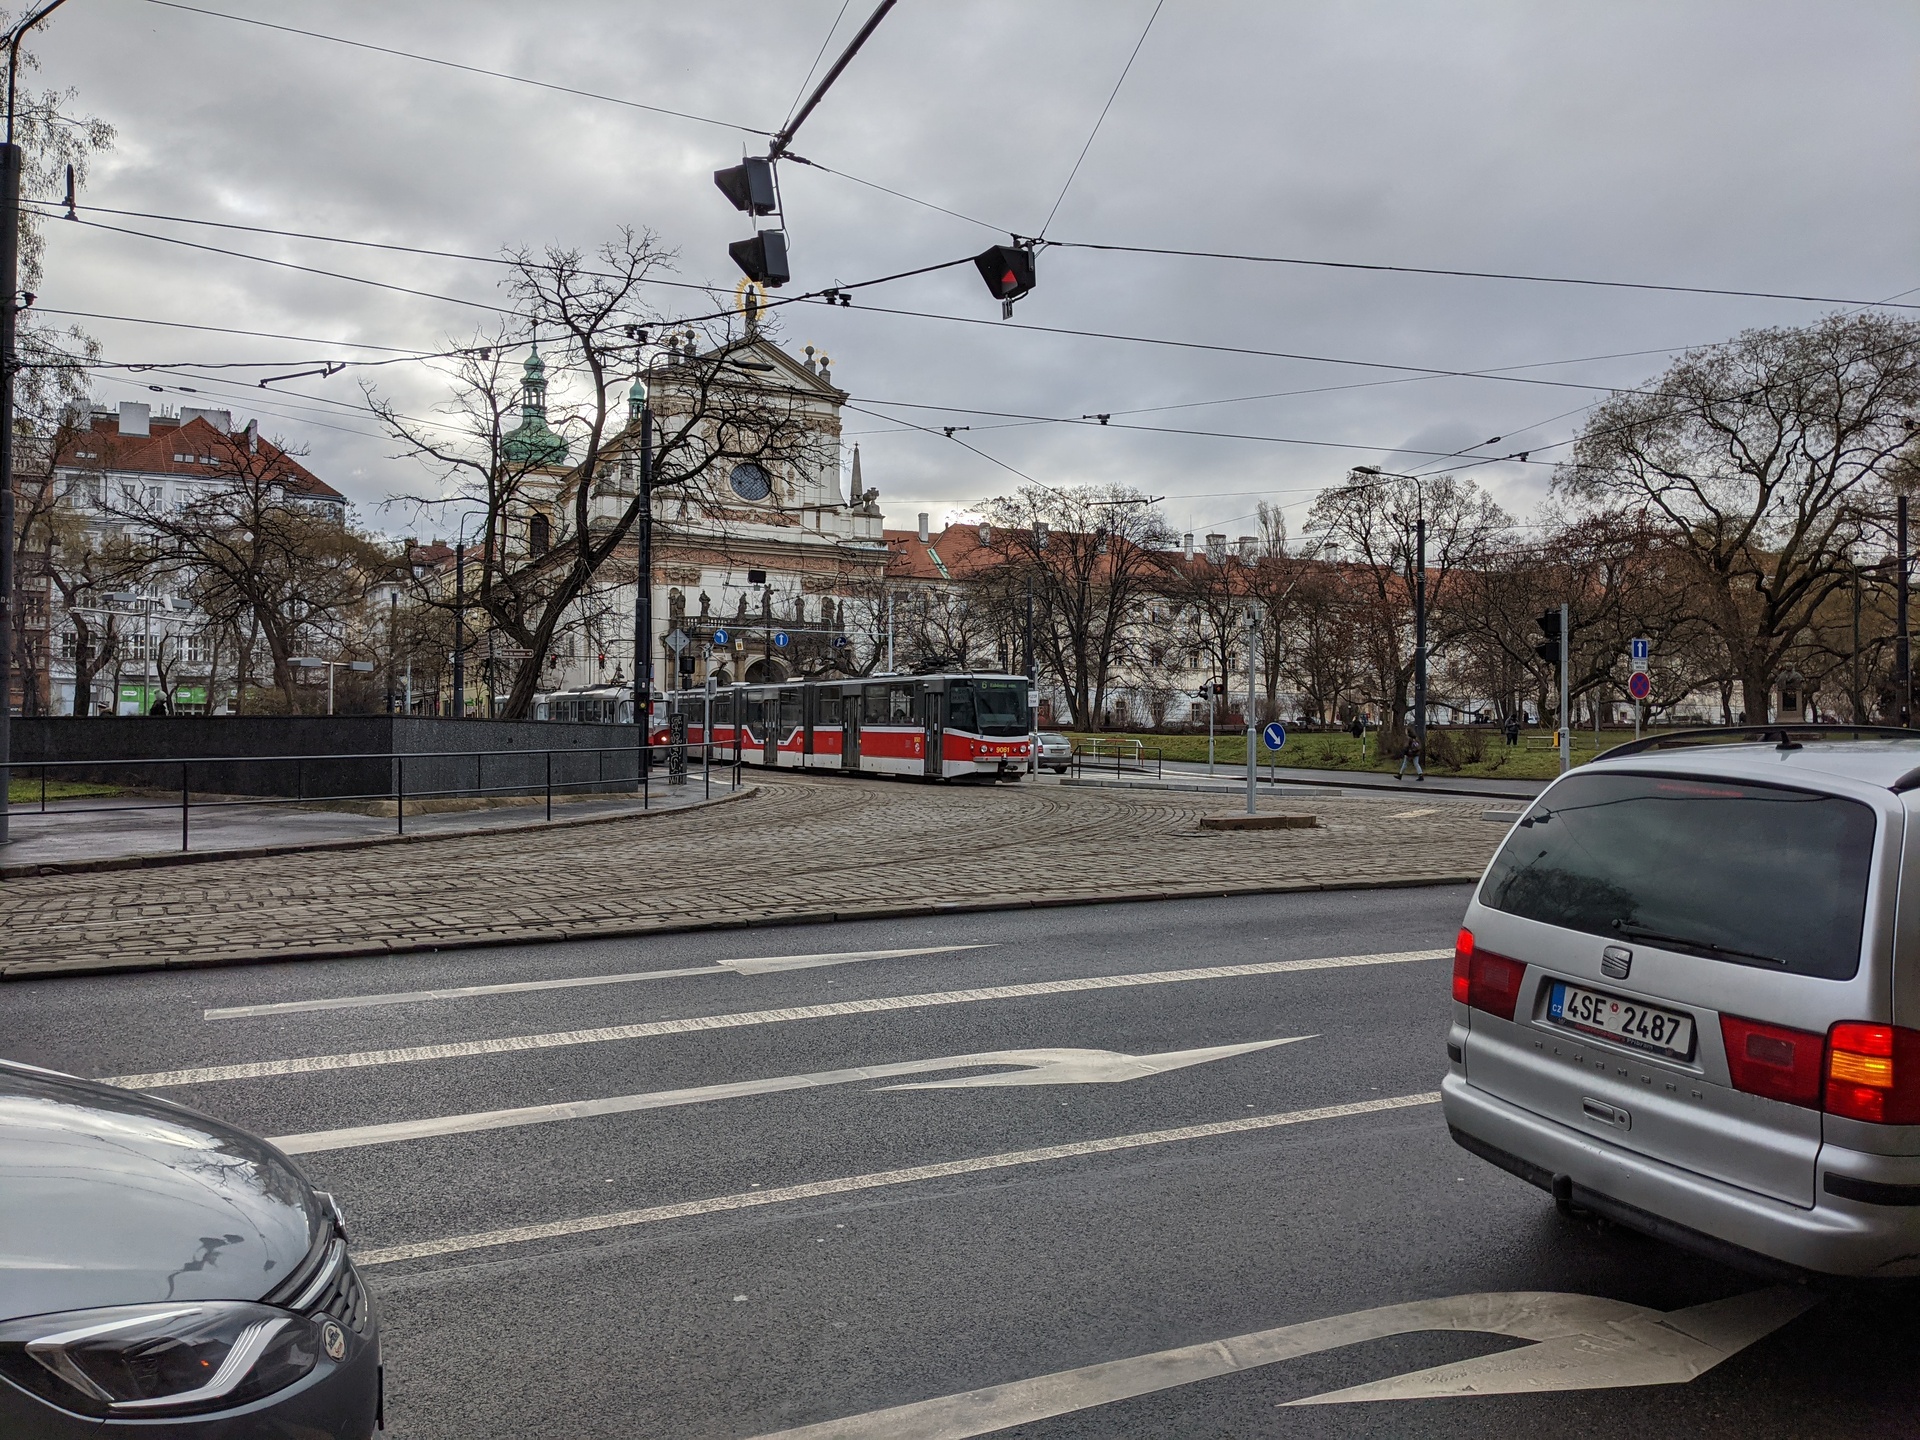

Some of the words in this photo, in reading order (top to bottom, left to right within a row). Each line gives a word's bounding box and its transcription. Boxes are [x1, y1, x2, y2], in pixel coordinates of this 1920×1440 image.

[982, 681, 988, 689] 6
[1552, 1003, 1562, 1013] CZ
[1567, 991, 1606, 1026] 4SE
[1621, 1006, 1681, 1046] 2487
[1534, 1040, 1703, 1100] ALHAMBRA
